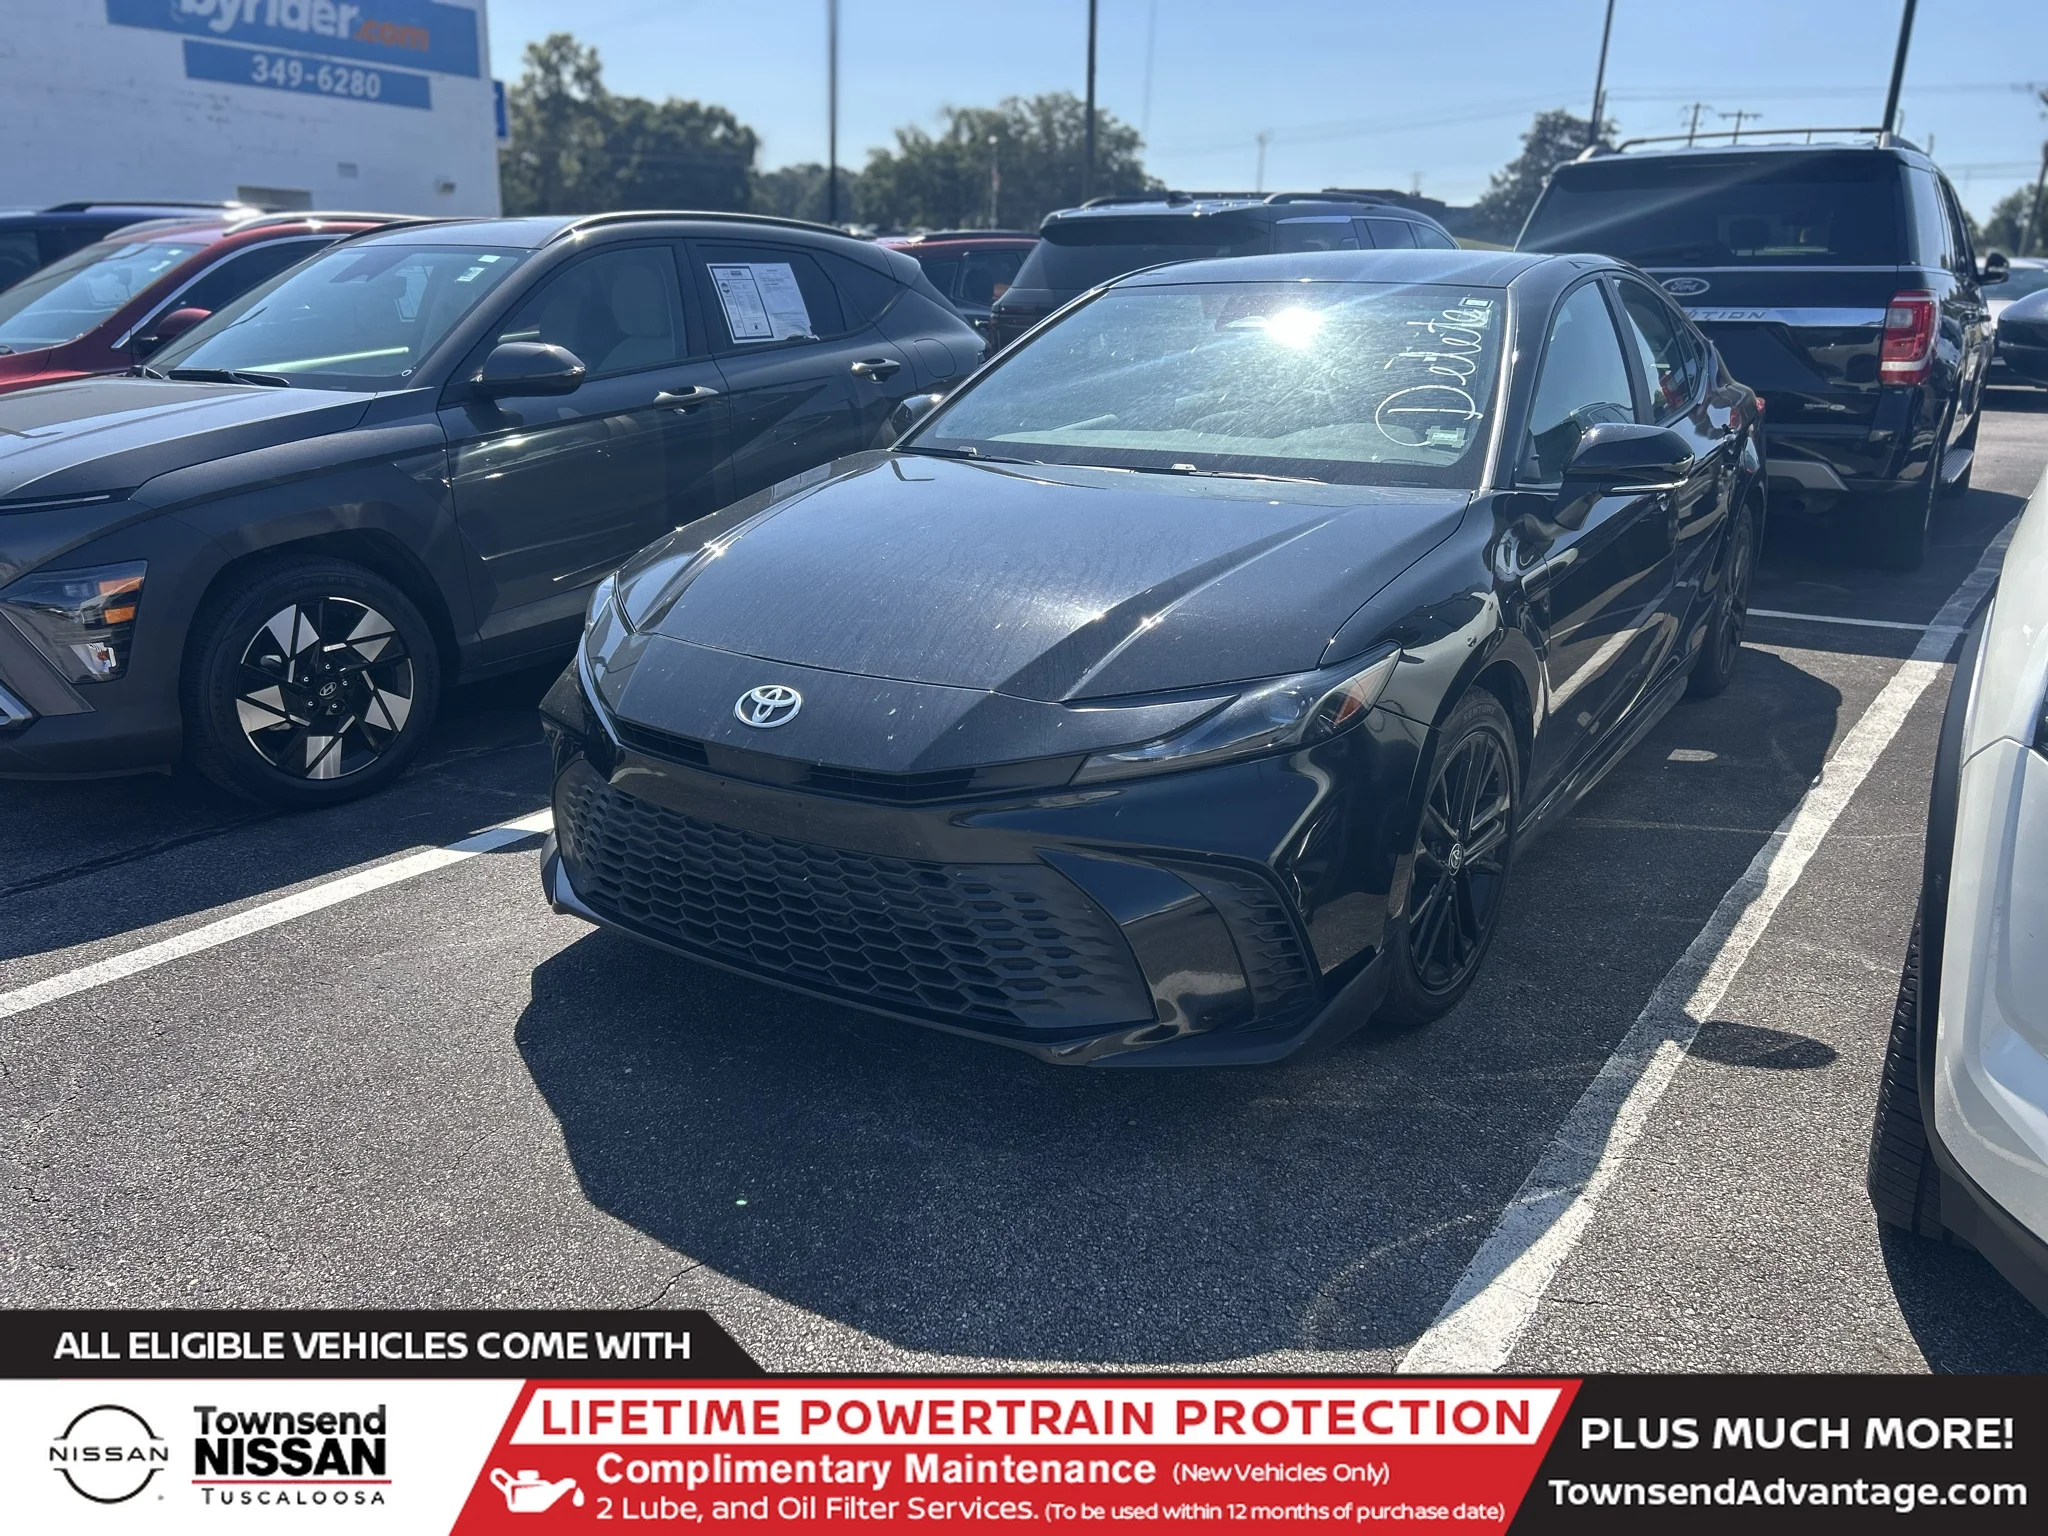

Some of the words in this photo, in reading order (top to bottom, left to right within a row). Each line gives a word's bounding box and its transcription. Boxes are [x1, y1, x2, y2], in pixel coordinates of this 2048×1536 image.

[251, 54, 382, 99] 349-6280
[1670, 280, 1699, 291] Ford
[1689, 311, 1766, 320] ITION
[1463, 705, 1495, 723] SENTURY
